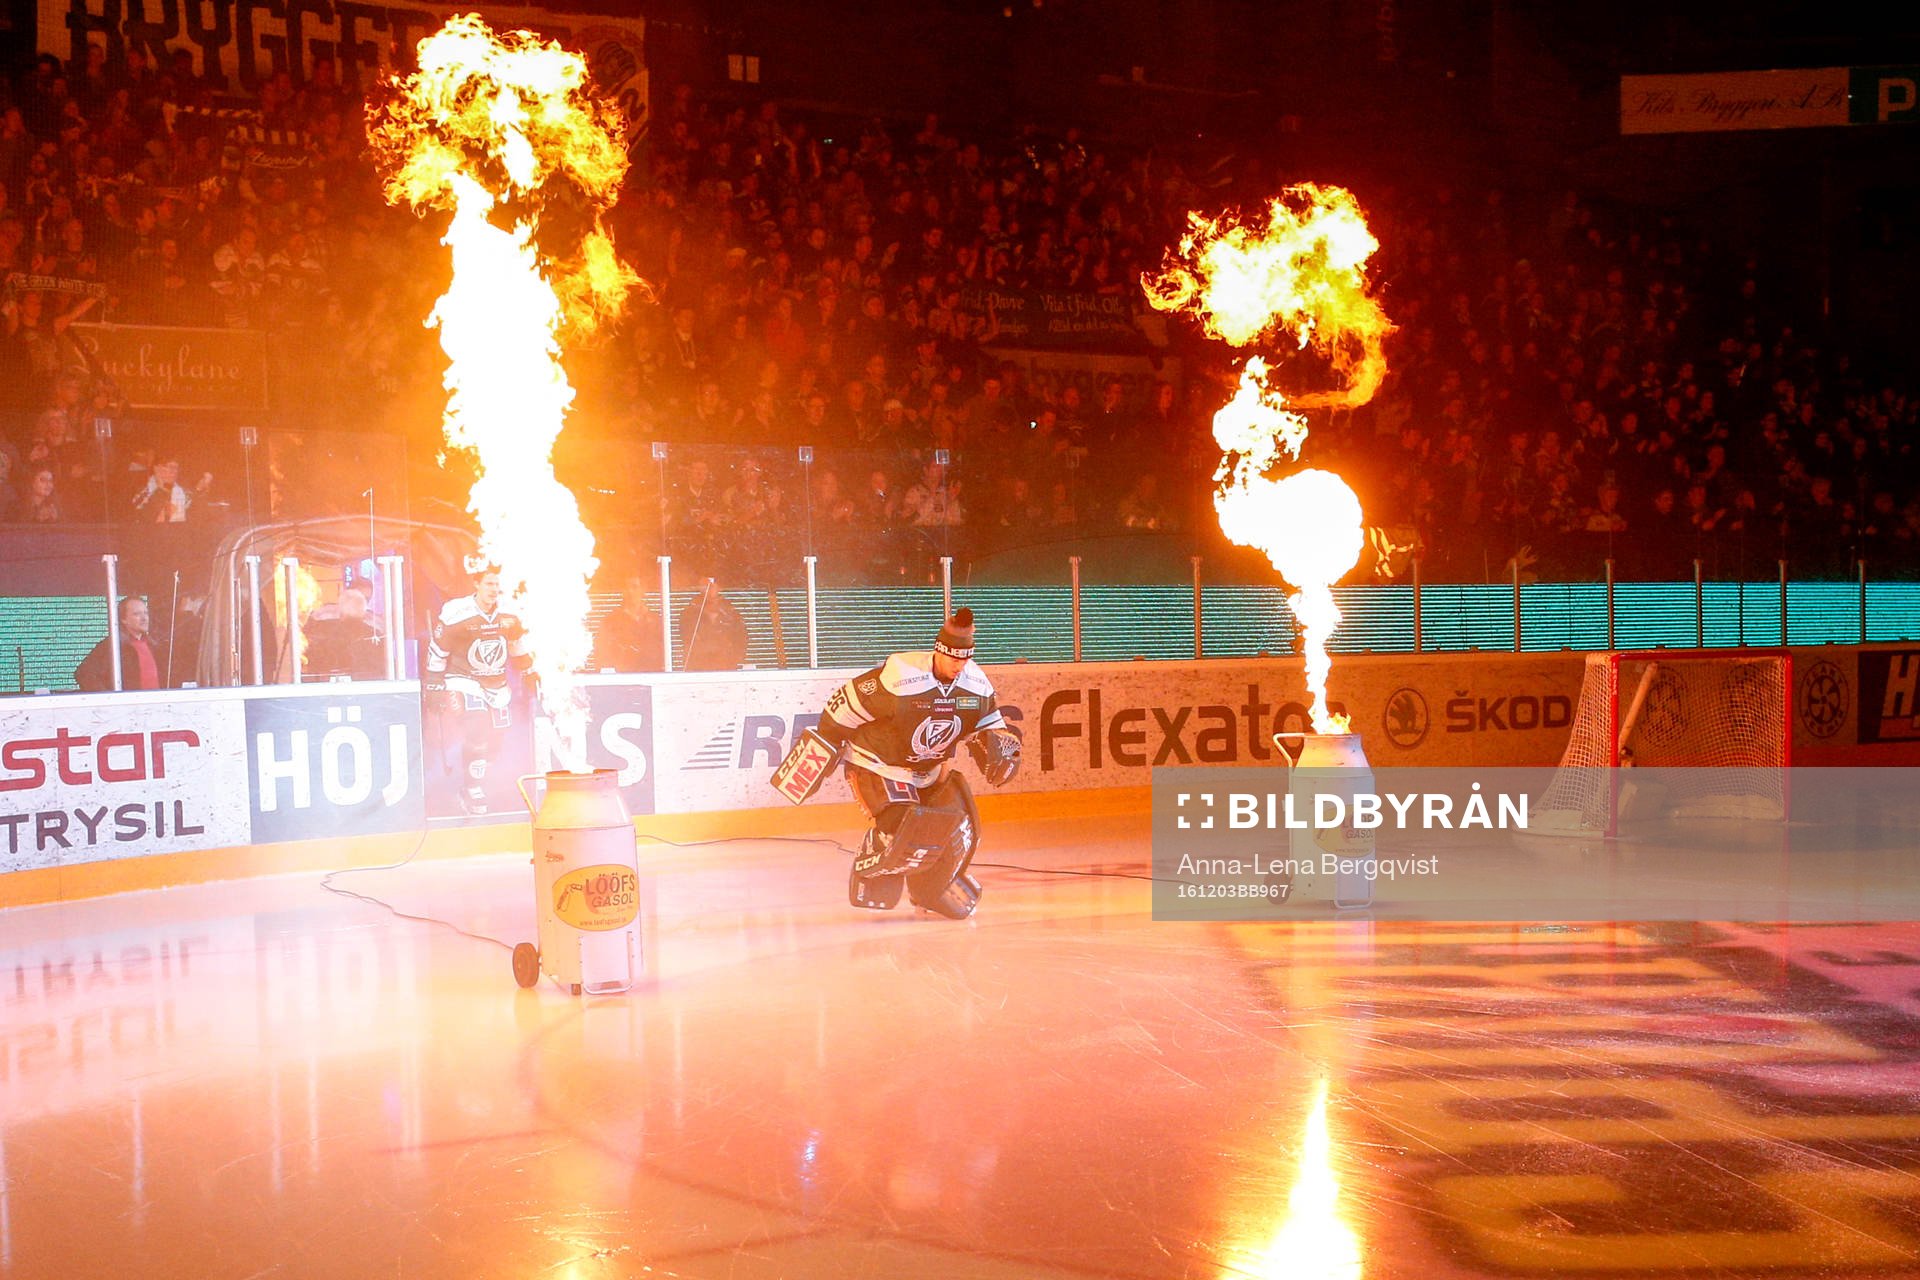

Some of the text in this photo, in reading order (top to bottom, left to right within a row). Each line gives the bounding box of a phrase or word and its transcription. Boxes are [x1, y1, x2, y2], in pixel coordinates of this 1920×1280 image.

[1040, 684, 1346, 771] Flexato
[1446, 690, 1574, 733] ŠKOD
[256, 705, 409, 812] HÖJ
[778, 739, 805, 780] CCM
[785, 746, 827, 799] MEX
[0, 799, 204, 854] TRYSIL
[585, 872, 635, 895] LÖÖFS
[855, 853, 882, 872] CCM
[591, 893, 634, 908] GASOL
